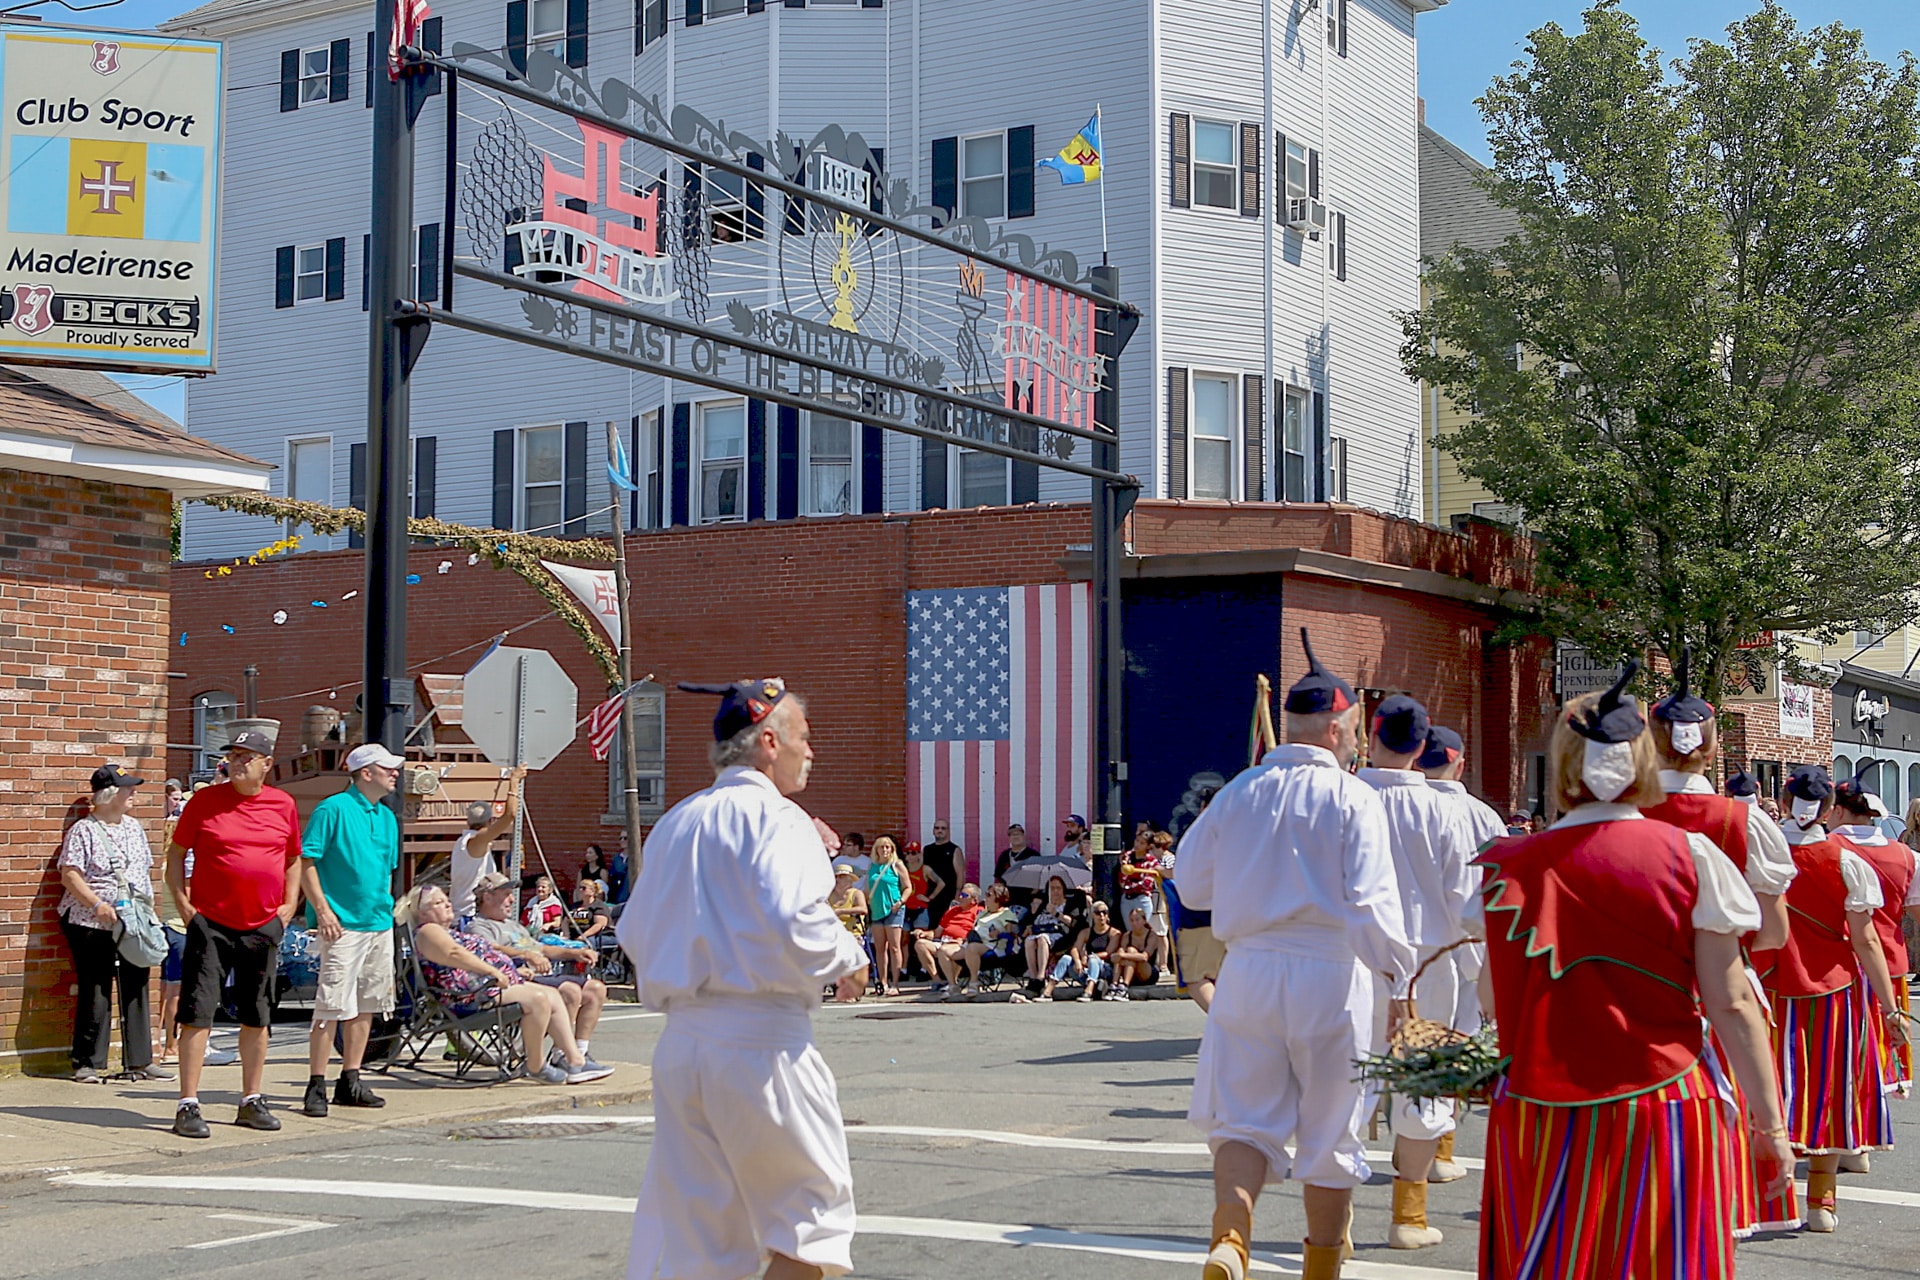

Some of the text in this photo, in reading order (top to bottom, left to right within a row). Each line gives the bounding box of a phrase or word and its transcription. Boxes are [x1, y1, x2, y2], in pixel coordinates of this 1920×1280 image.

[16, 98, 196, 137] Club Sport
[825, 162, 866, 204] 1915
[6, 247, 194, 281] Madeirense
[519, 227, 666, 298] MADEIRA
[62, 300, 191, 327] BECK'S
[66, 330, 190, 348] Proudly Served
[772, 316, 909, 380] GATEWAY TO
[1010, 324, 1097, 389] AMERICA
[590, 308, 1037, 452] FEAST OF THE BLESSED SACRAMENT
[234, 732, 249, 744] B
